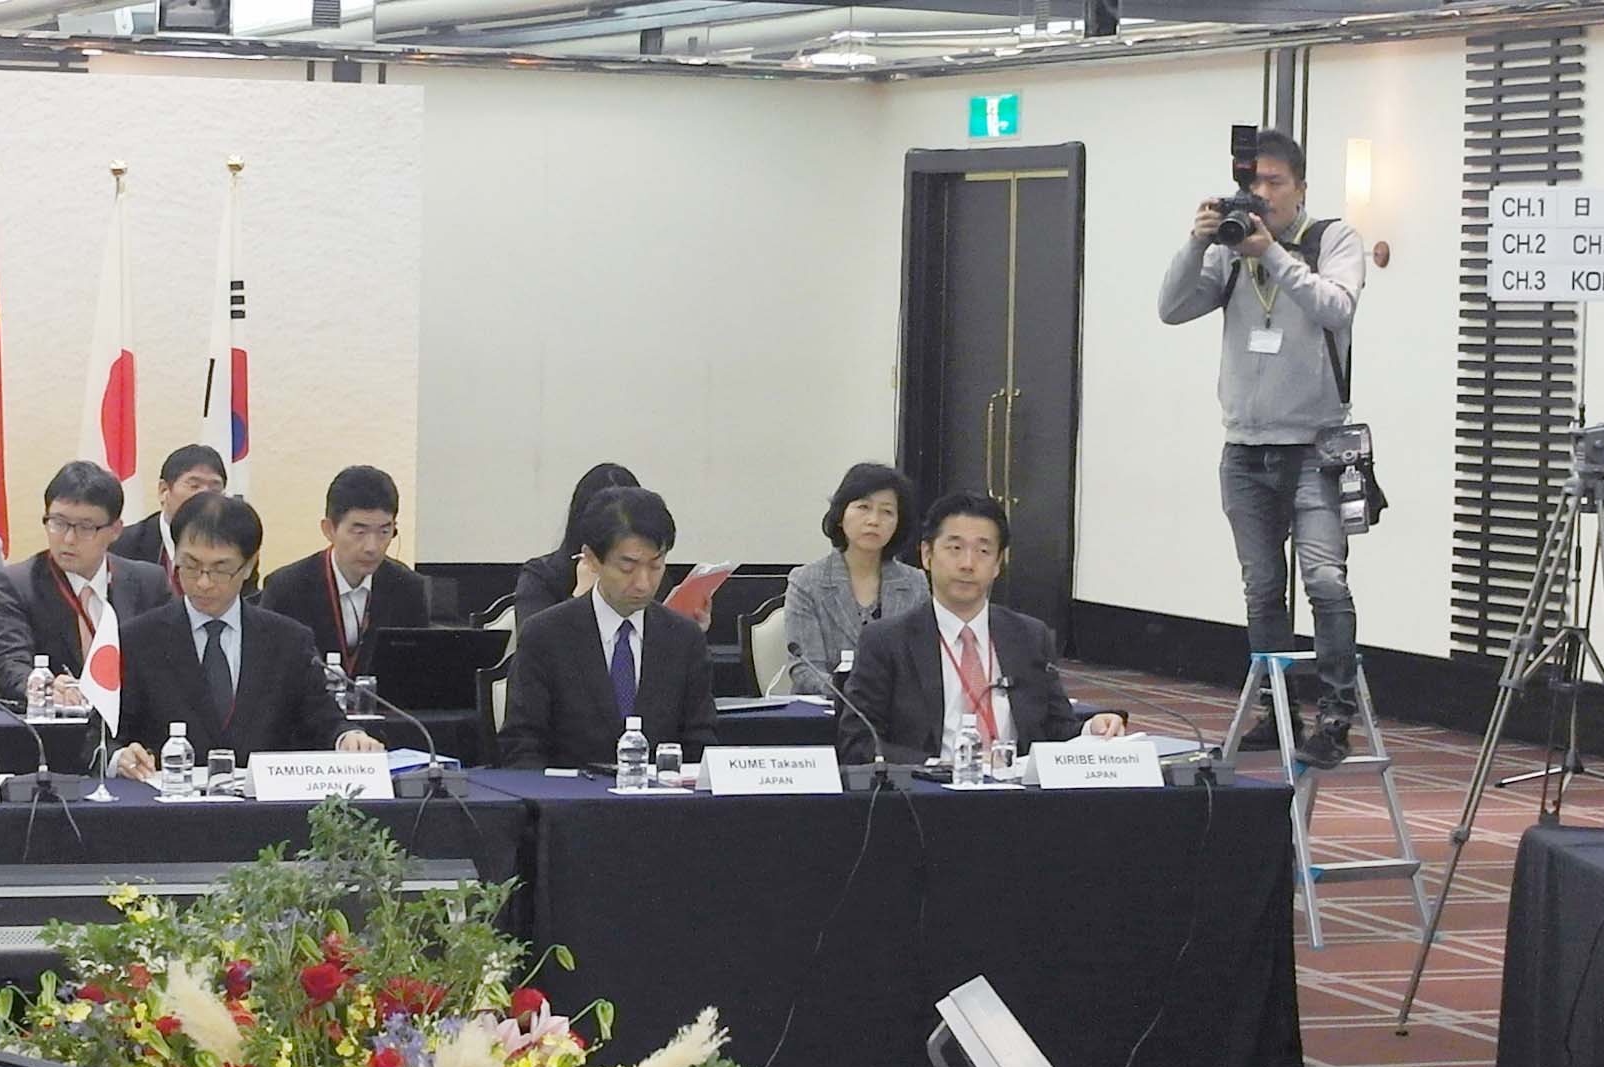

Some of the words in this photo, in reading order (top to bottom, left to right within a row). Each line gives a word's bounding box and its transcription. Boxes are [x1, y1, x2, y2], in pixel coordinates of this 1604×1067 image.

[1502, 196, 1546, 218] CH.1
[1502, 233, 1546, 254] CH.2
[1502, 270, 1546, 291] CH.3
[729, 759, 766, 769] KUME
[770, 759, 816, 769] Takashi
[1098, 754, 1139, 765] Hitoshi
[267, 765, 325, 776] TAMURA
[327, 764, 375, 775] Akihiko
[1085, 771, 1117, 779] JAPAN
[758, 776, 793, 785] JAPAN
